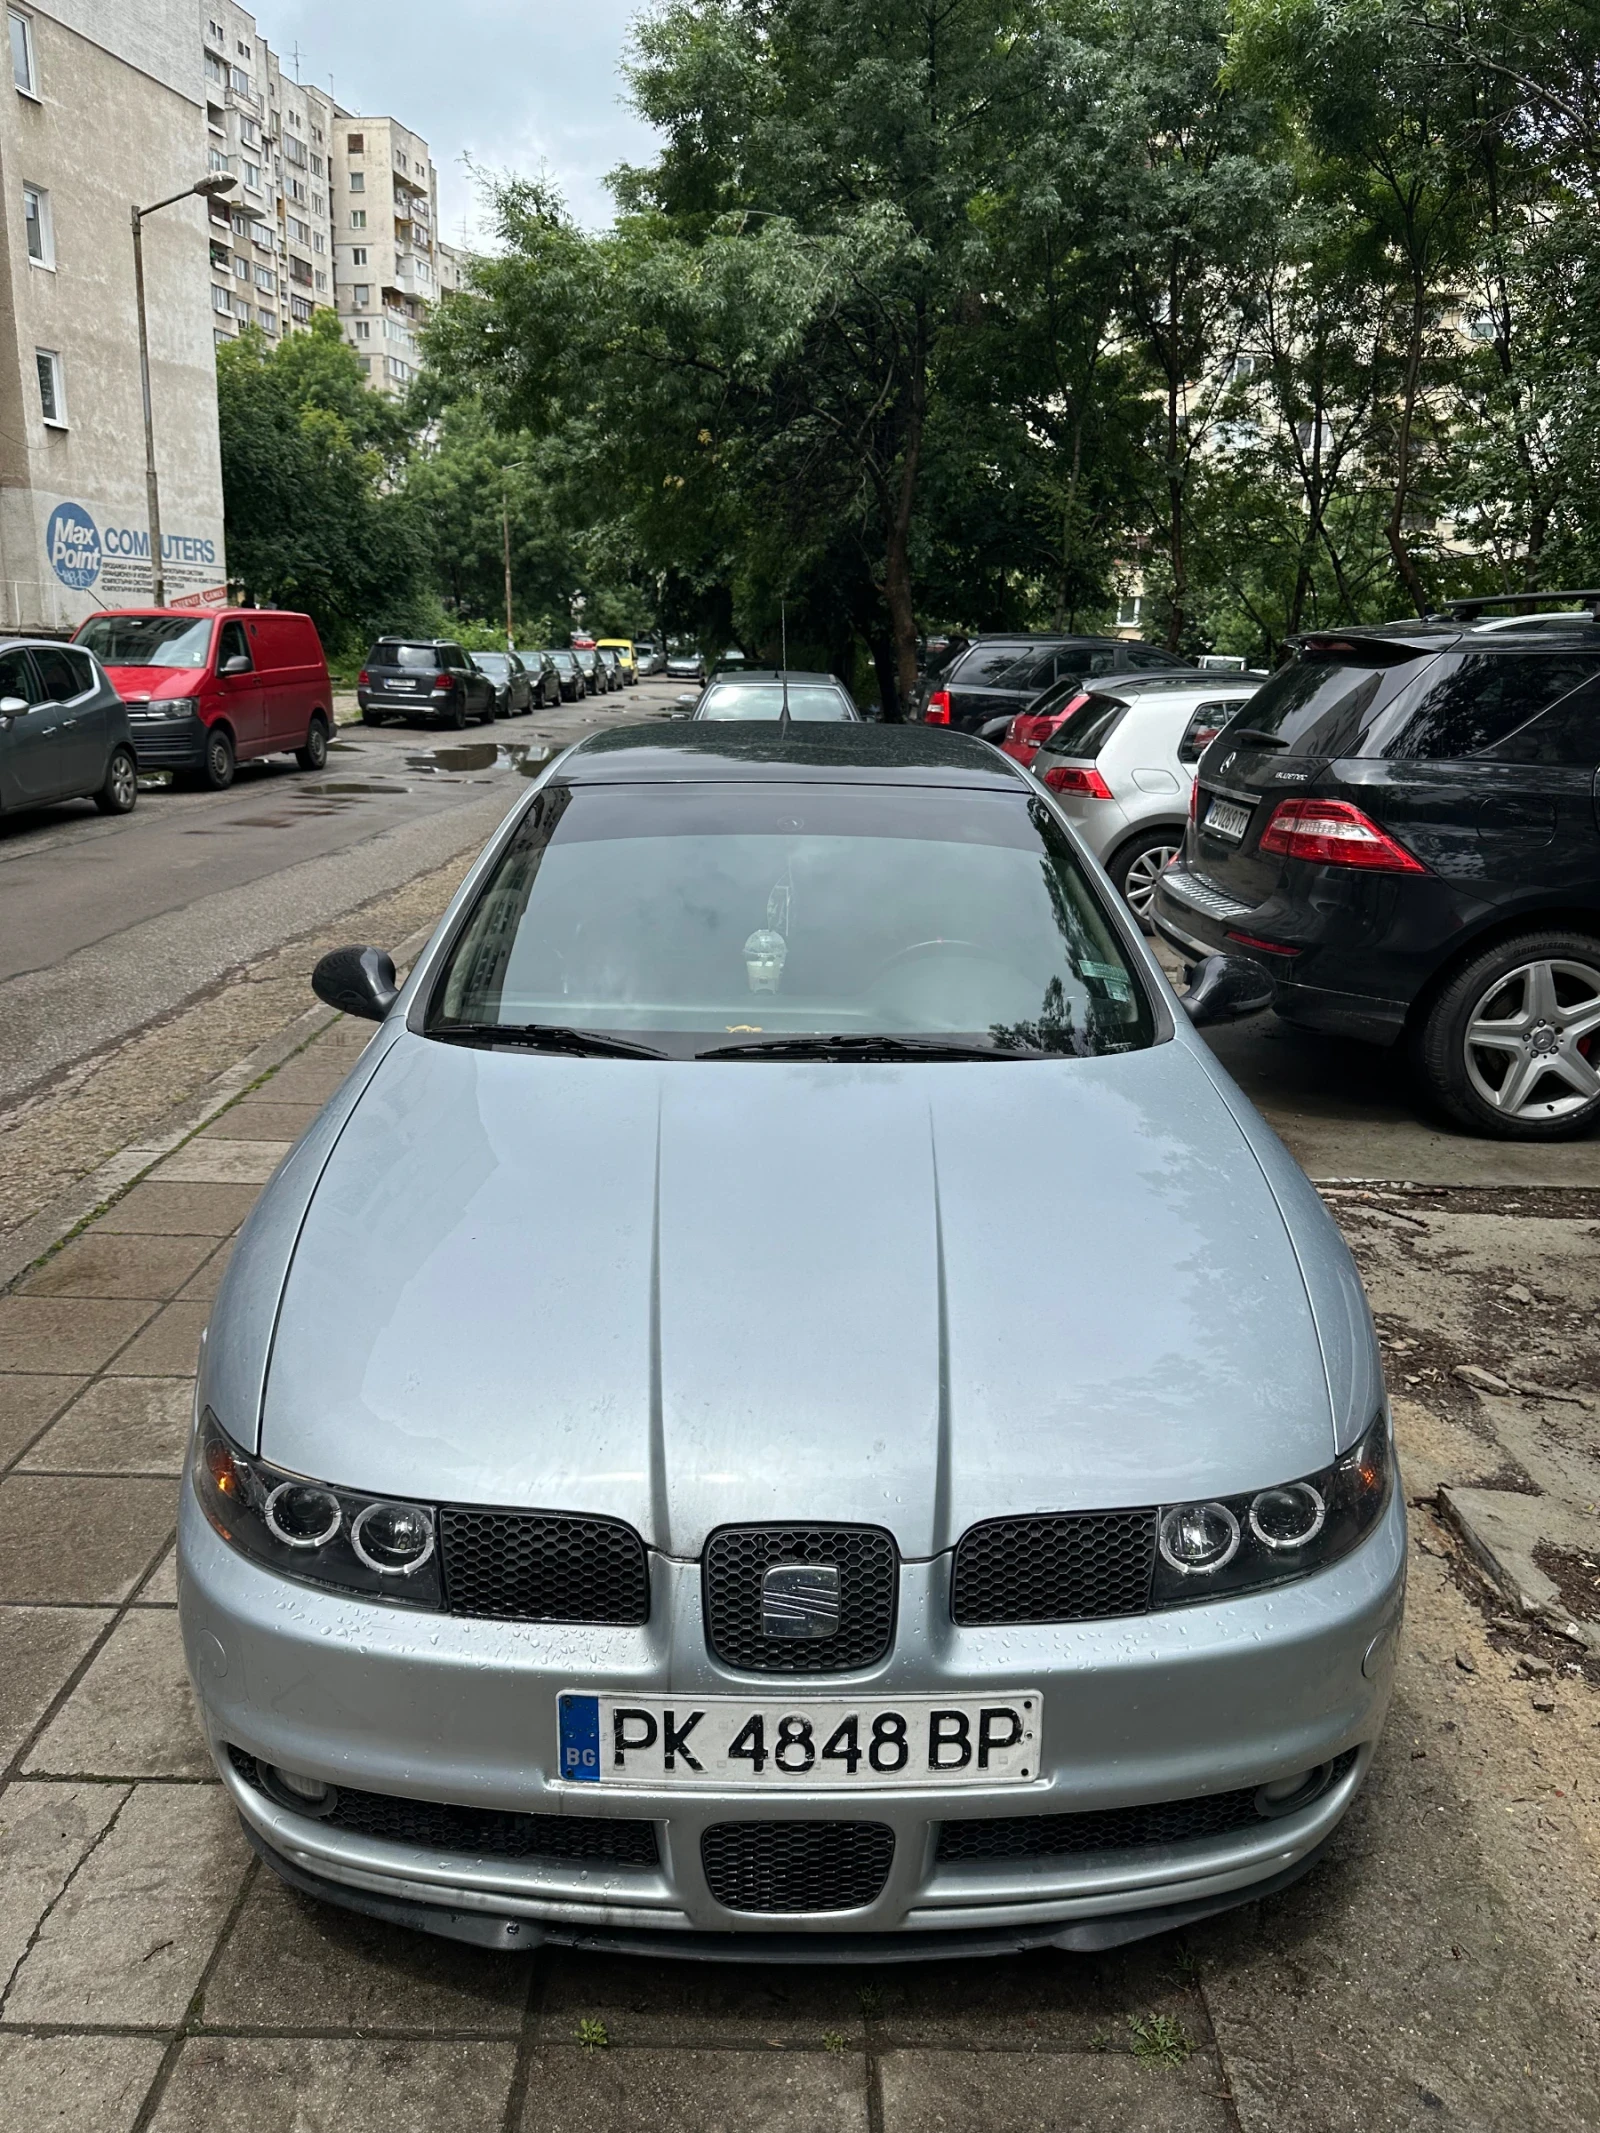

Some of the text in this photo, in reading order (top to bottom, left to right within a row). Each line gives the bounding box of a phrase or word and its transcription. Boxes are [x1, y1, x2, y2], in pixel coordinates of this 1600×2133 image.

[54, 517, 94, 546] Max
[105, 527, 215, 564] COMUTERS
[52, 541, 101, 570] Point
[567, 1707, 1023, 1774] BG PK 4848 BP
